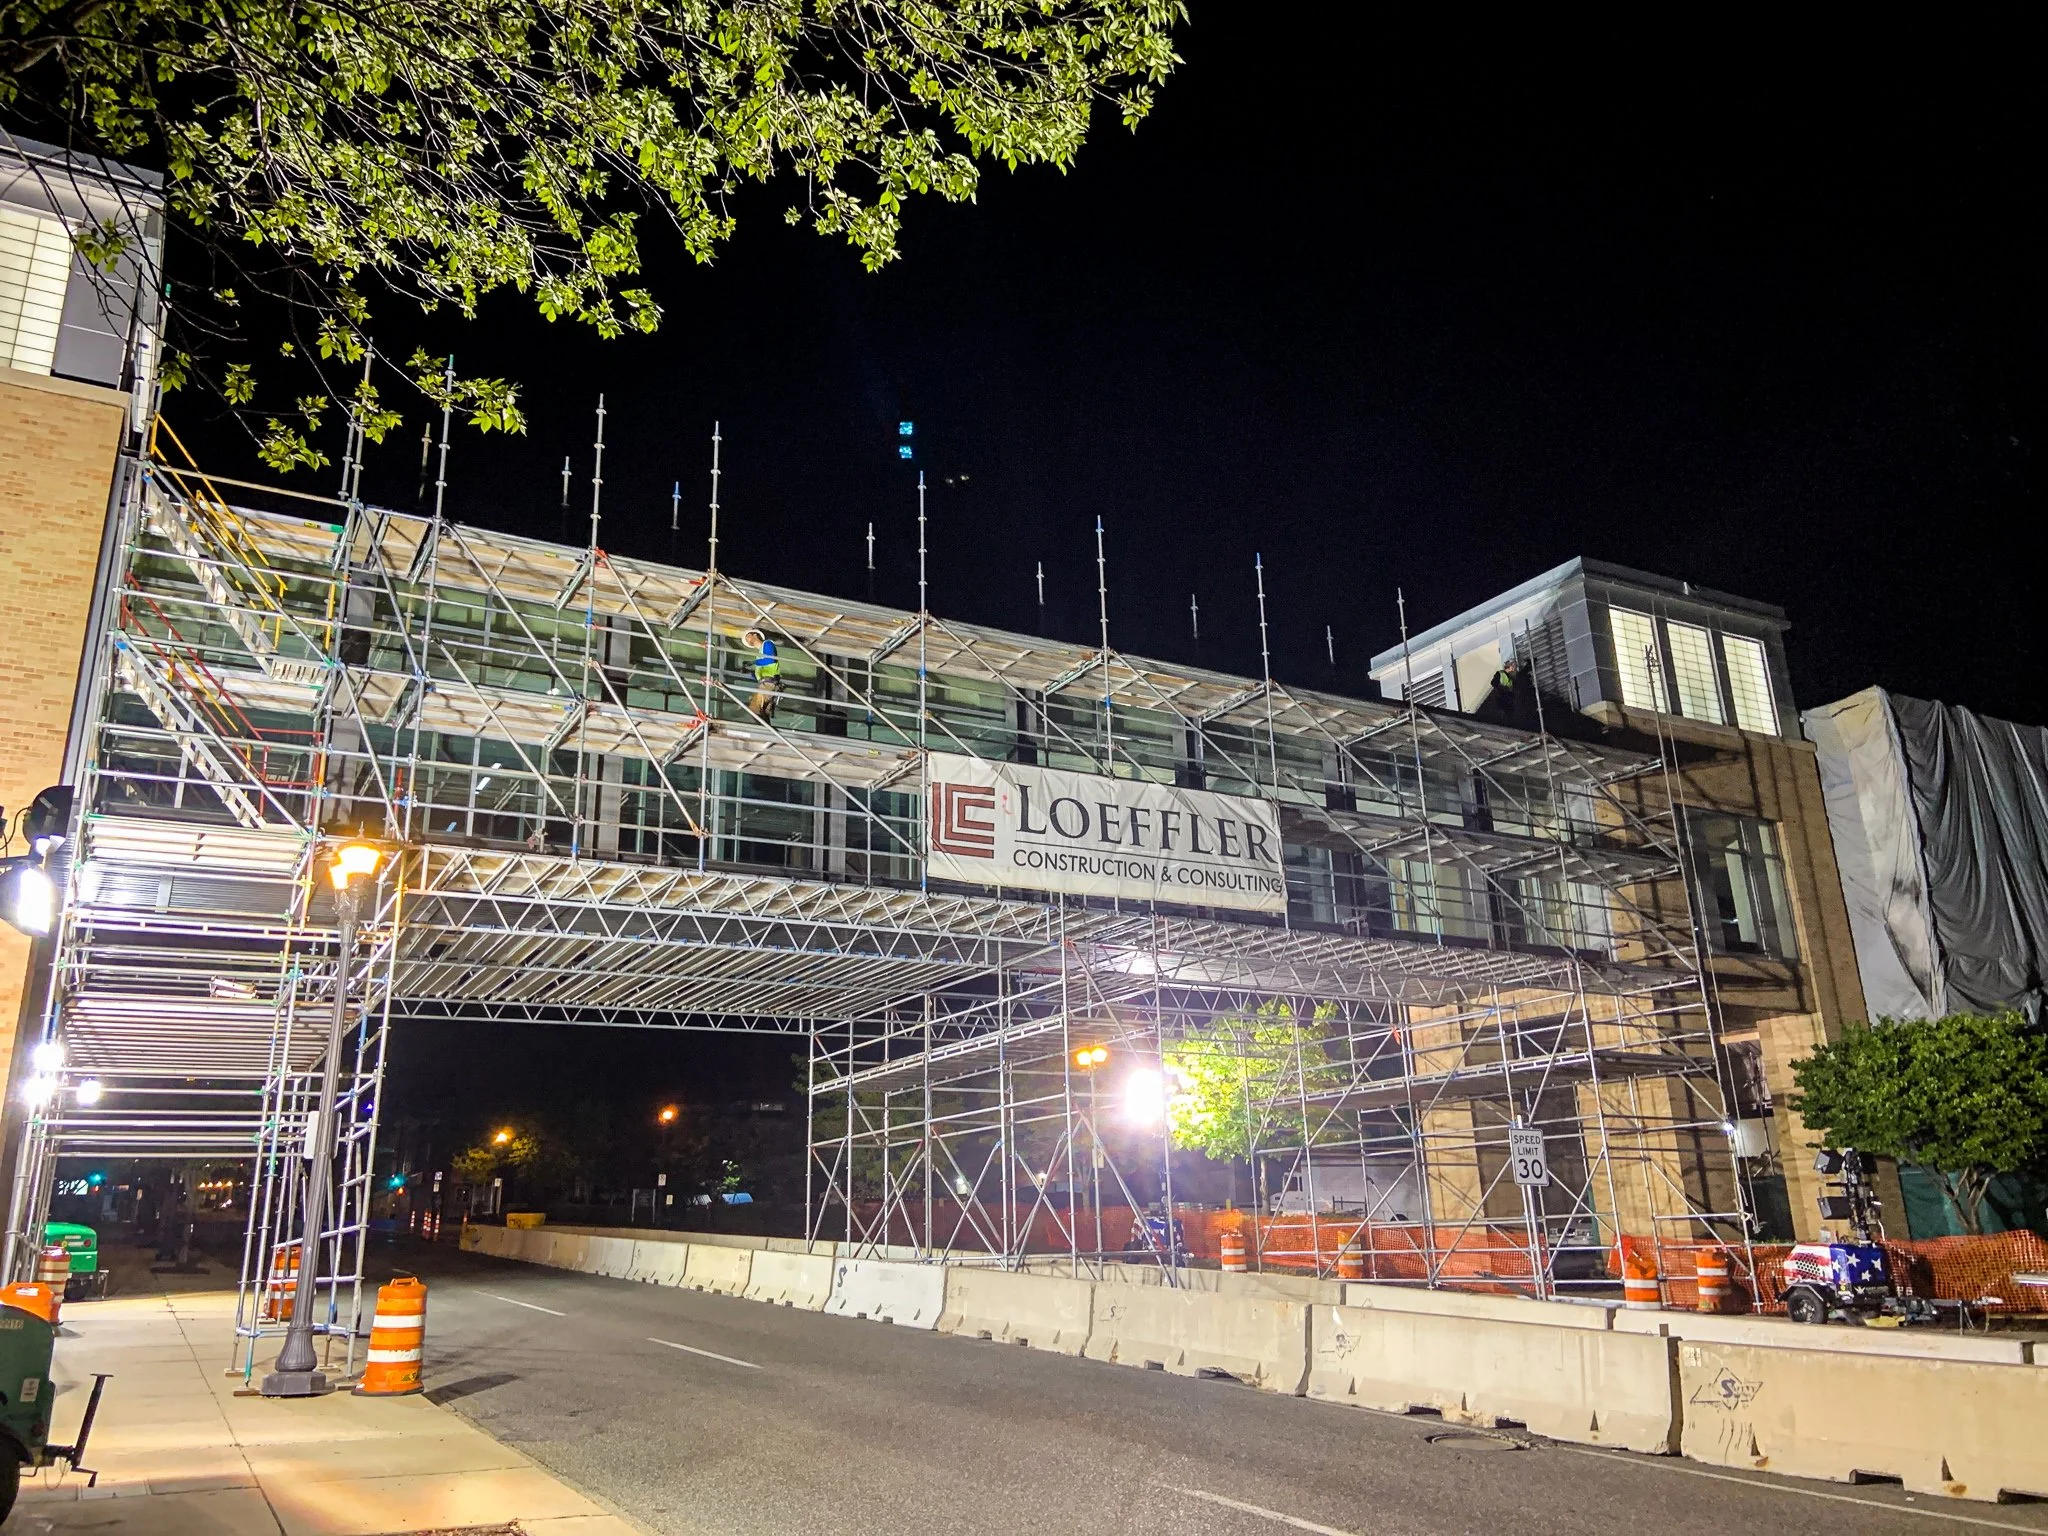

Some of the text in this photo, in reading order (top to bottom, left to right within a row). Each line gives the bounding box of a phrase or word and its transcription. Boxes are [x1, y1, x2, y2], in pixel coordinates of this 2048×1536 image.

[1015, 783, 1279, 864] LOEFFLER
[1013, 849, 1283, 893] CONSTRUCTION & CONSULTING
[1513, 1134, 1541, 1145] SPEED
[1517, 1147, 1539, 1156] LIMIT
[1518, 1158, 1543, 1179] 30
